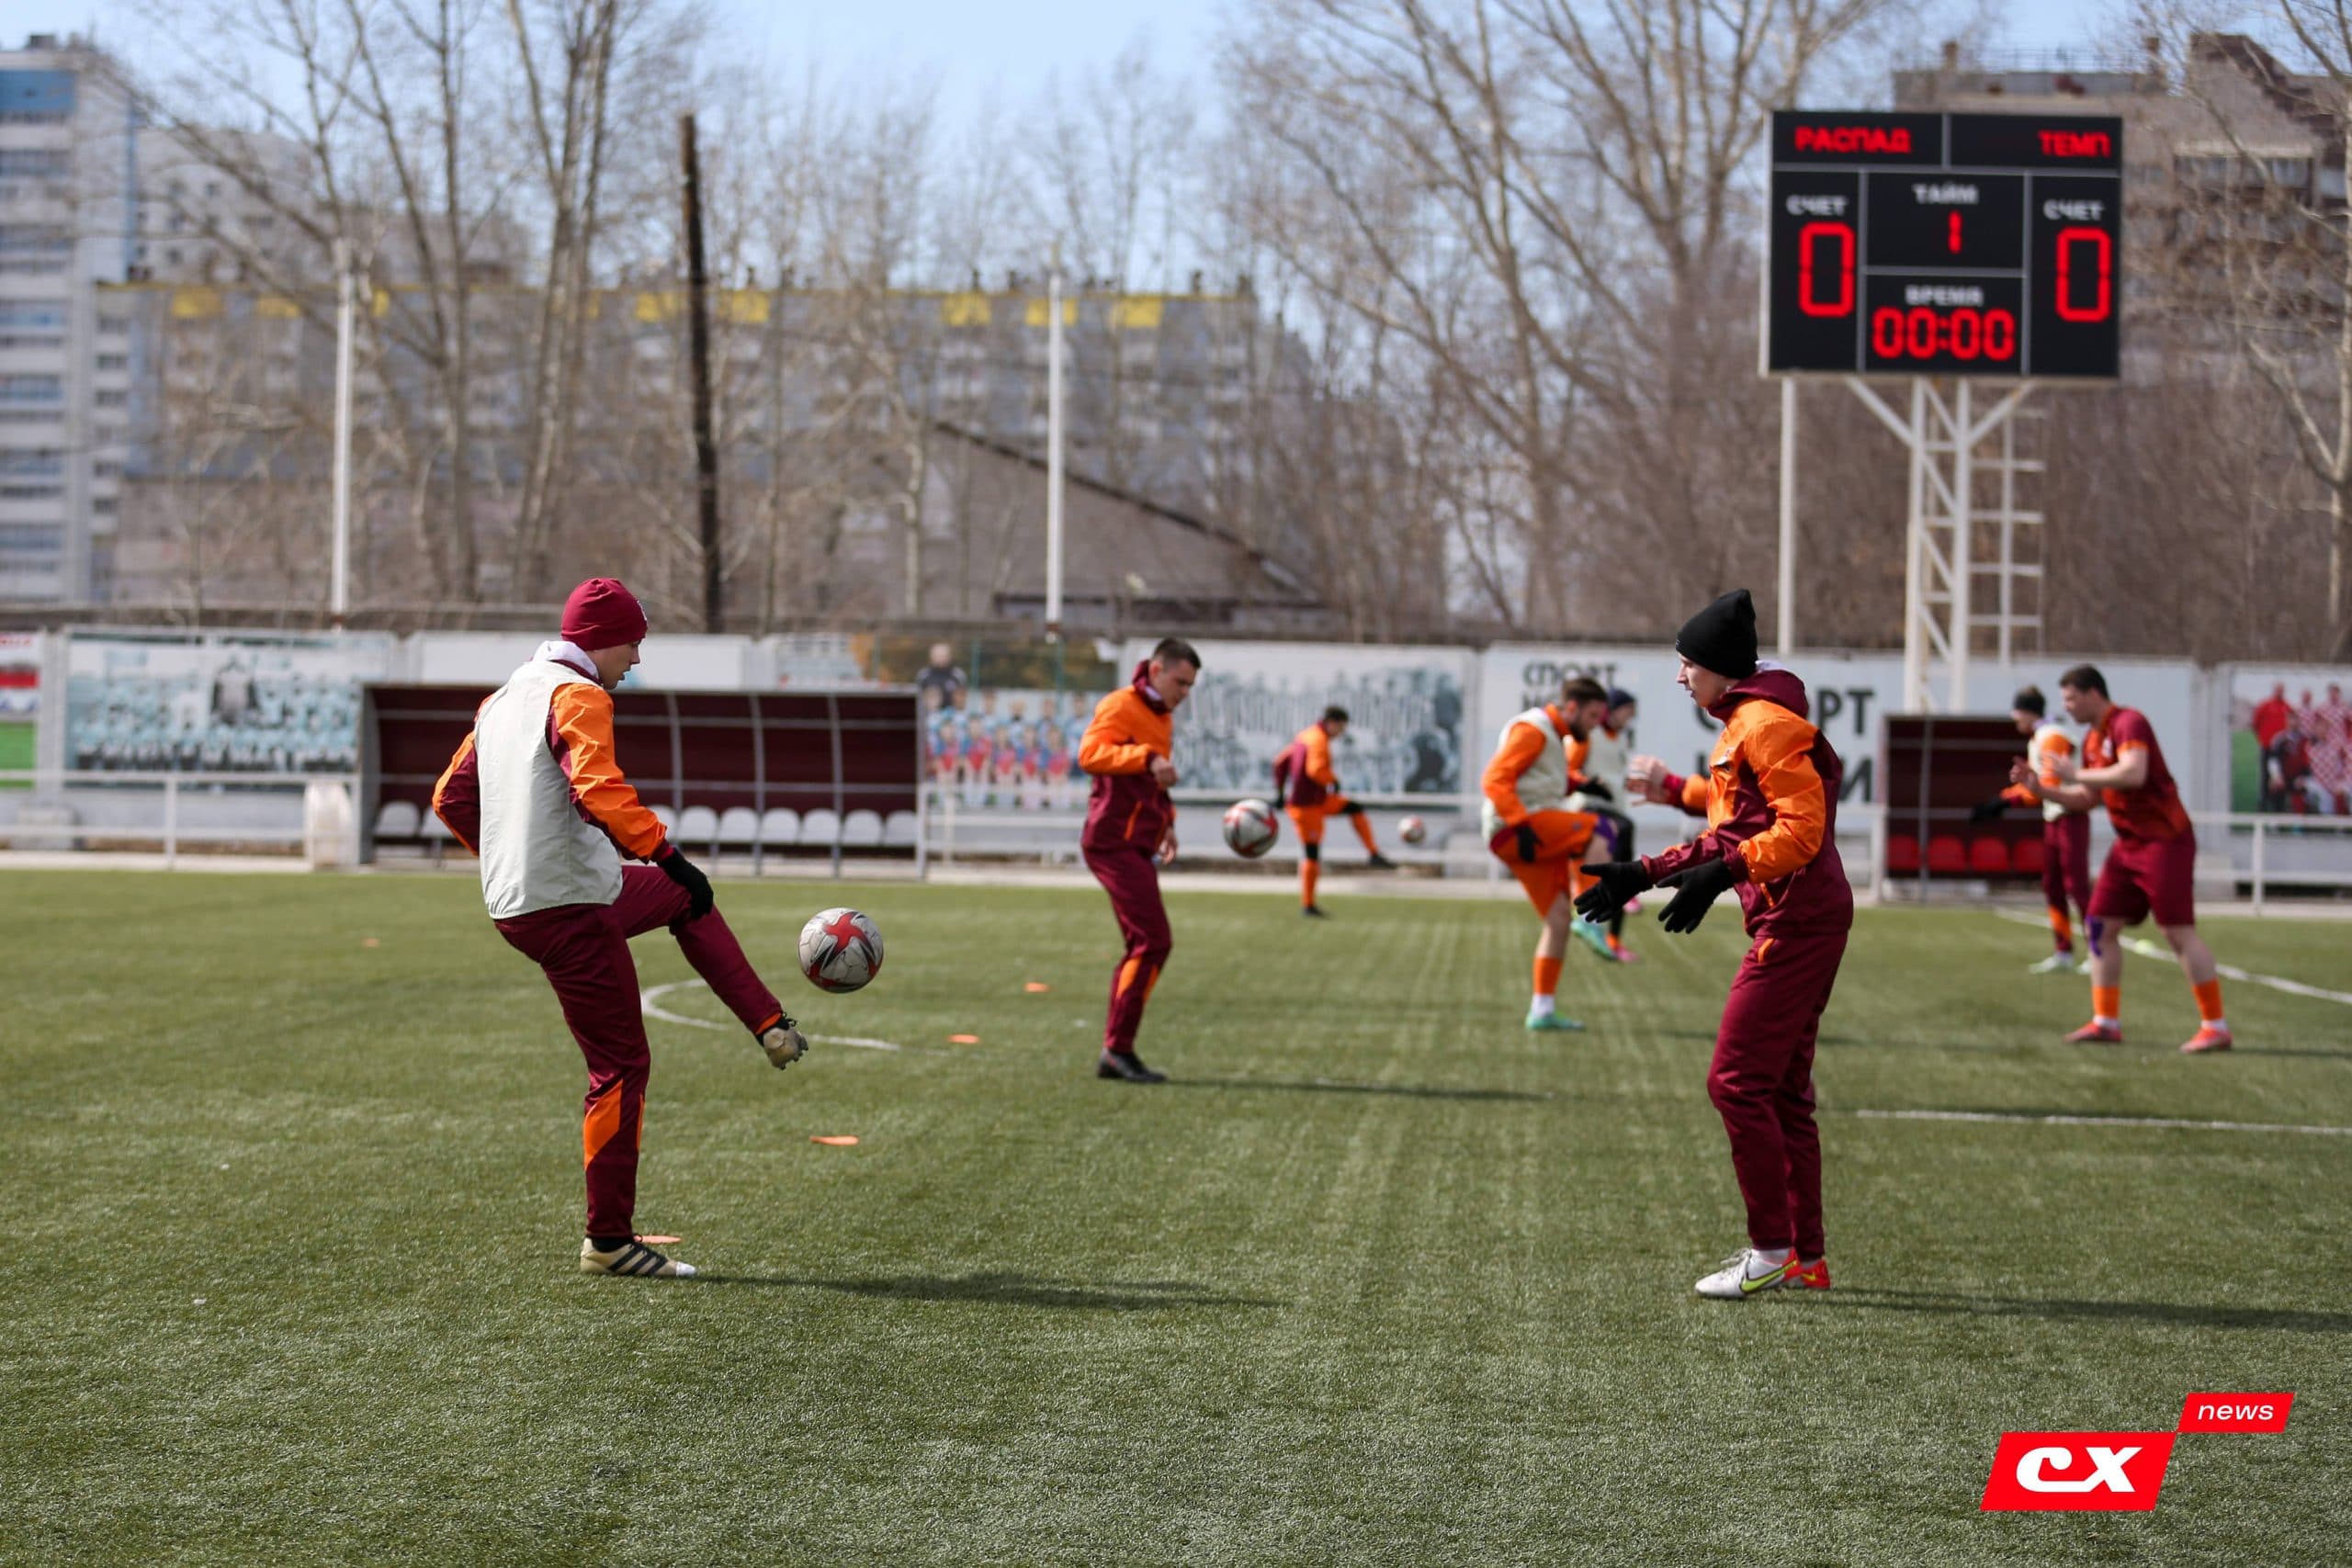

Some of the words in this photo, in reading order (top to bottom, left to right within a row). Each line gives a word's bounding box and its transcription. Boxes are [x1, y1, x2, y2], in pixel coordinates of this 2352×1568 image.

[1794, 127, 1912, 153] РАСПАД
[2039, 131, 2111, 157] ТЕМП
[1786, 196, 1846, 216] СЧЕТ
[2043, 200, 2103, 220] СЧЕТ
[1948, 211, 1962, 254] 1
[1798, 220, 1856, 318] 0
[2054, 226, 2112, 323] 0
[1905, 286, 1984, 306] ВРЕМЯ
[1871, 306, 2016, 361] 00:00
